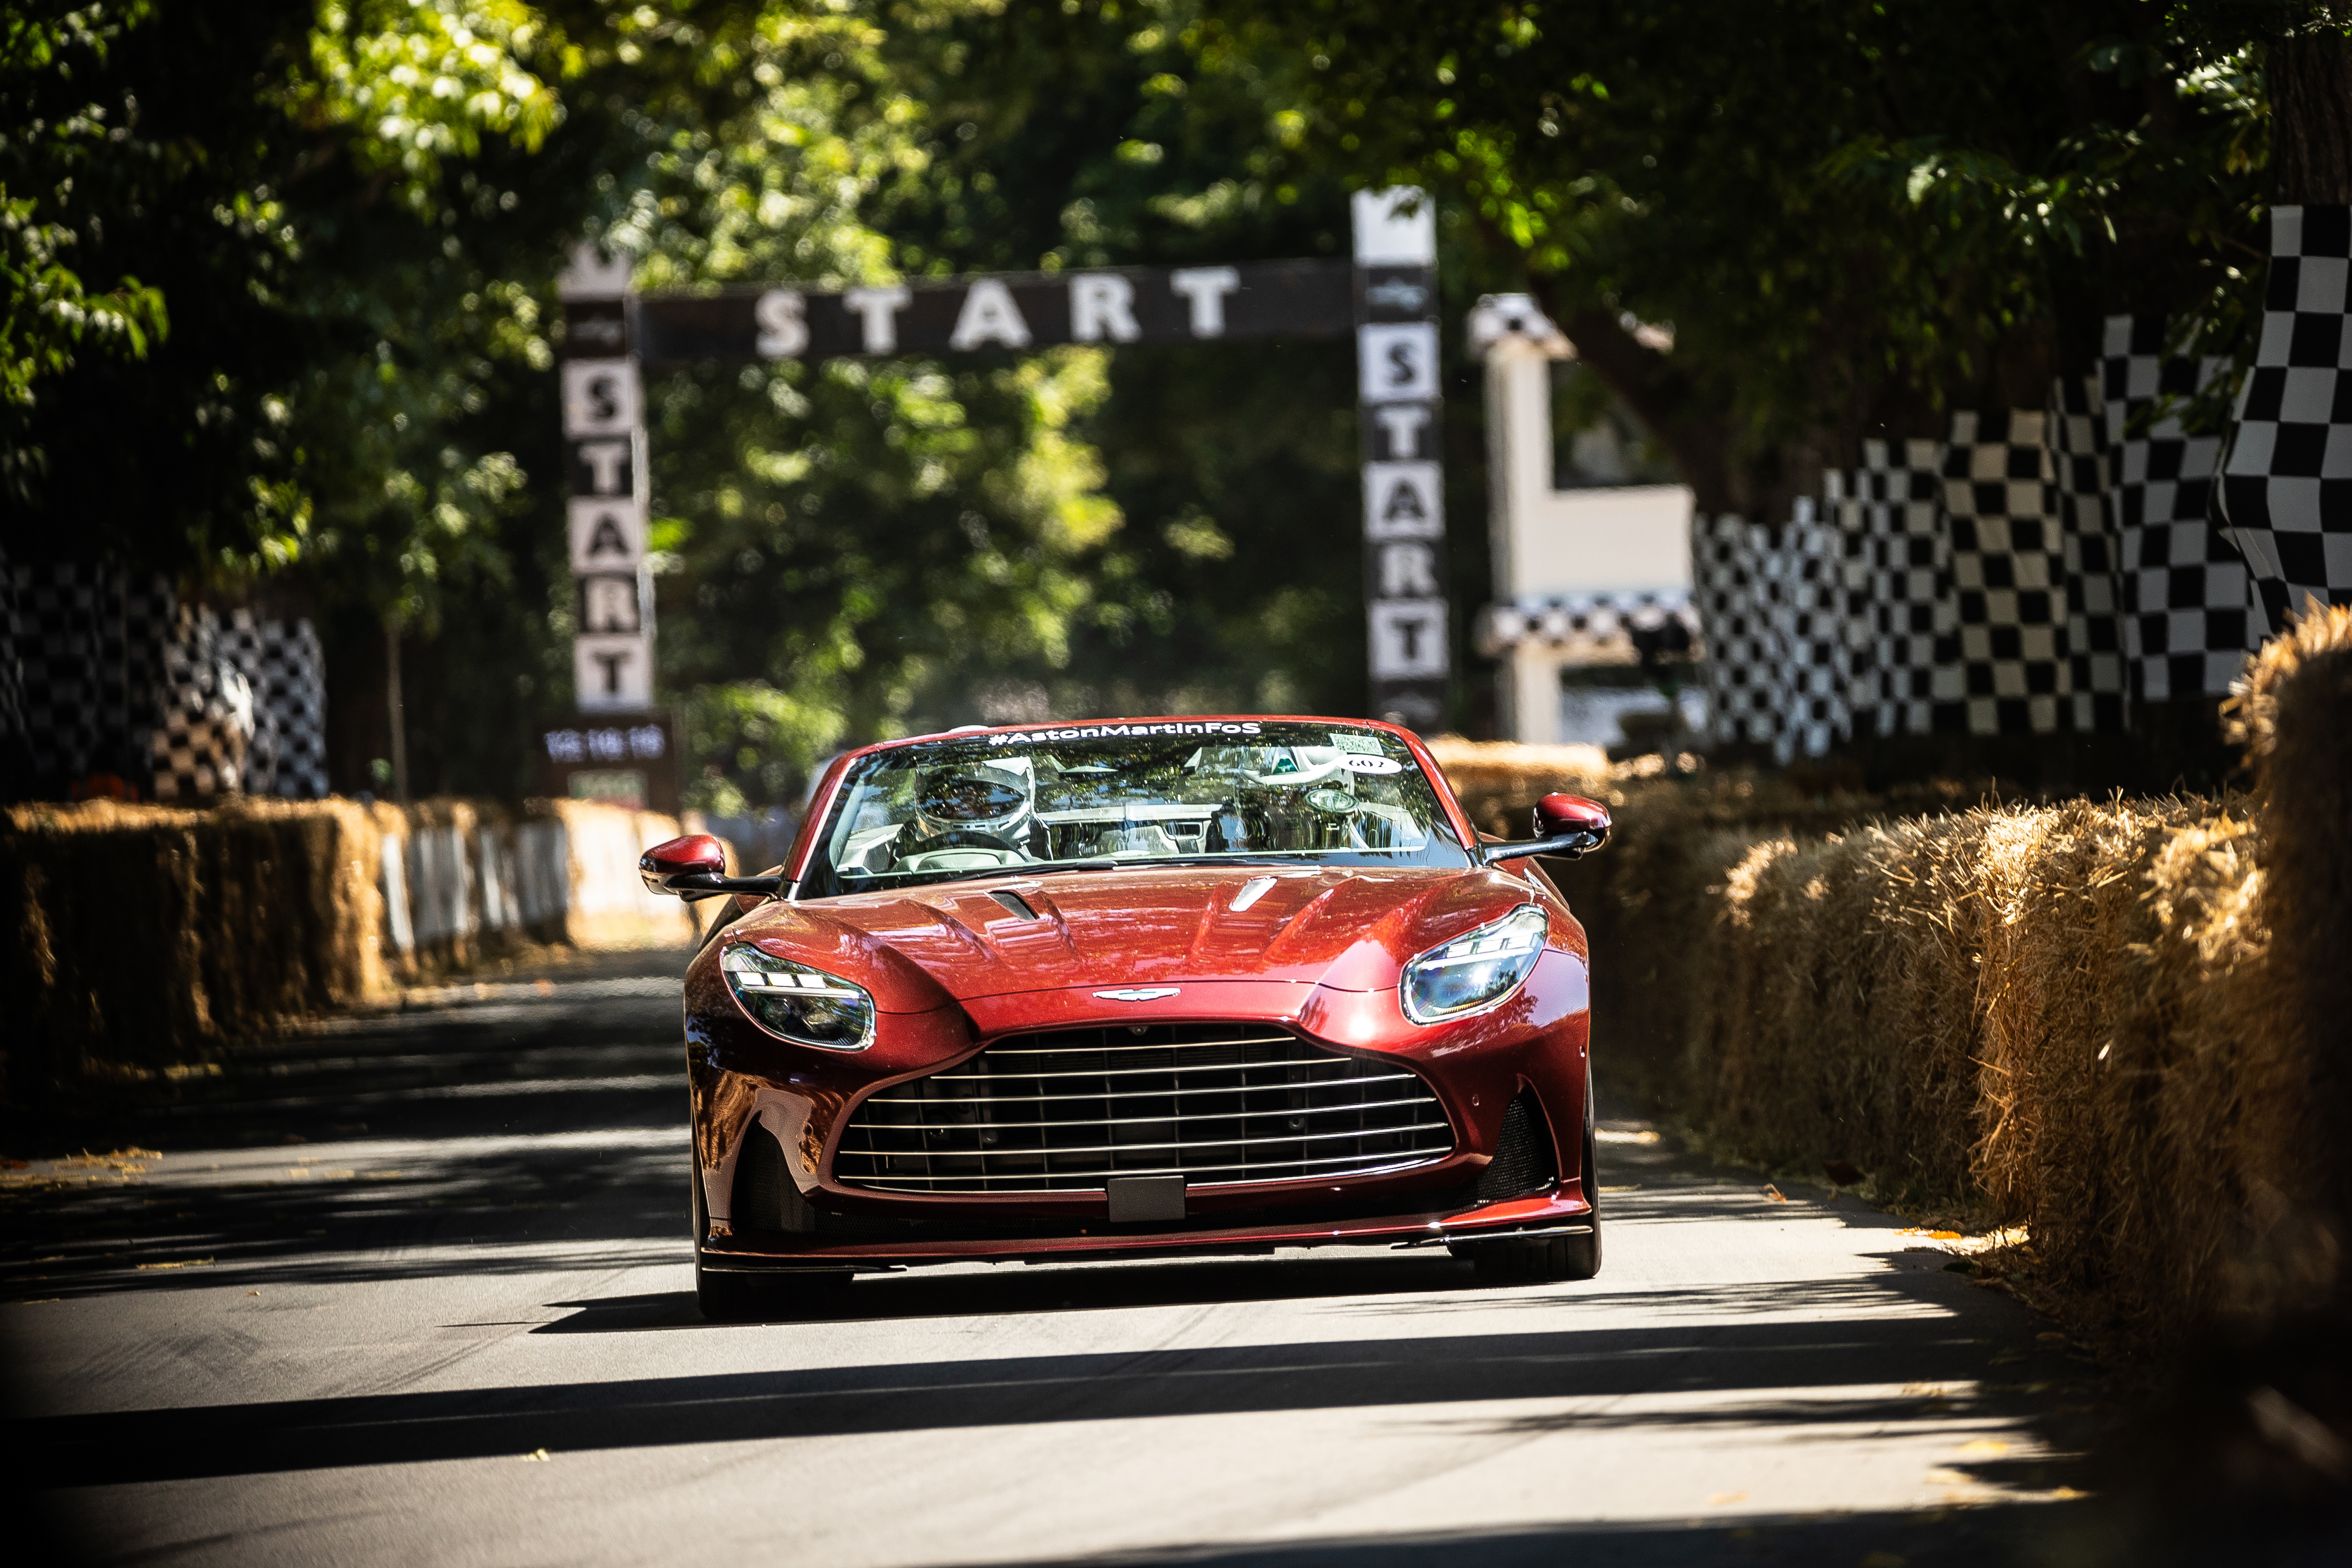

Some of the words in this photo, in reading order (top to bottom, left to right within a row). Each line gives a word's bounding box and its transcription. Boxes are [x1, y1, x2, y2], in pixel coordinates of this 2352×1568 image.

[755, 266, 1240, 358] START
[578, 374, 640, 694] START
[1376, 340, 1438, 660] START
[989, 723, 1261, 746] #AstonMartinFoS
